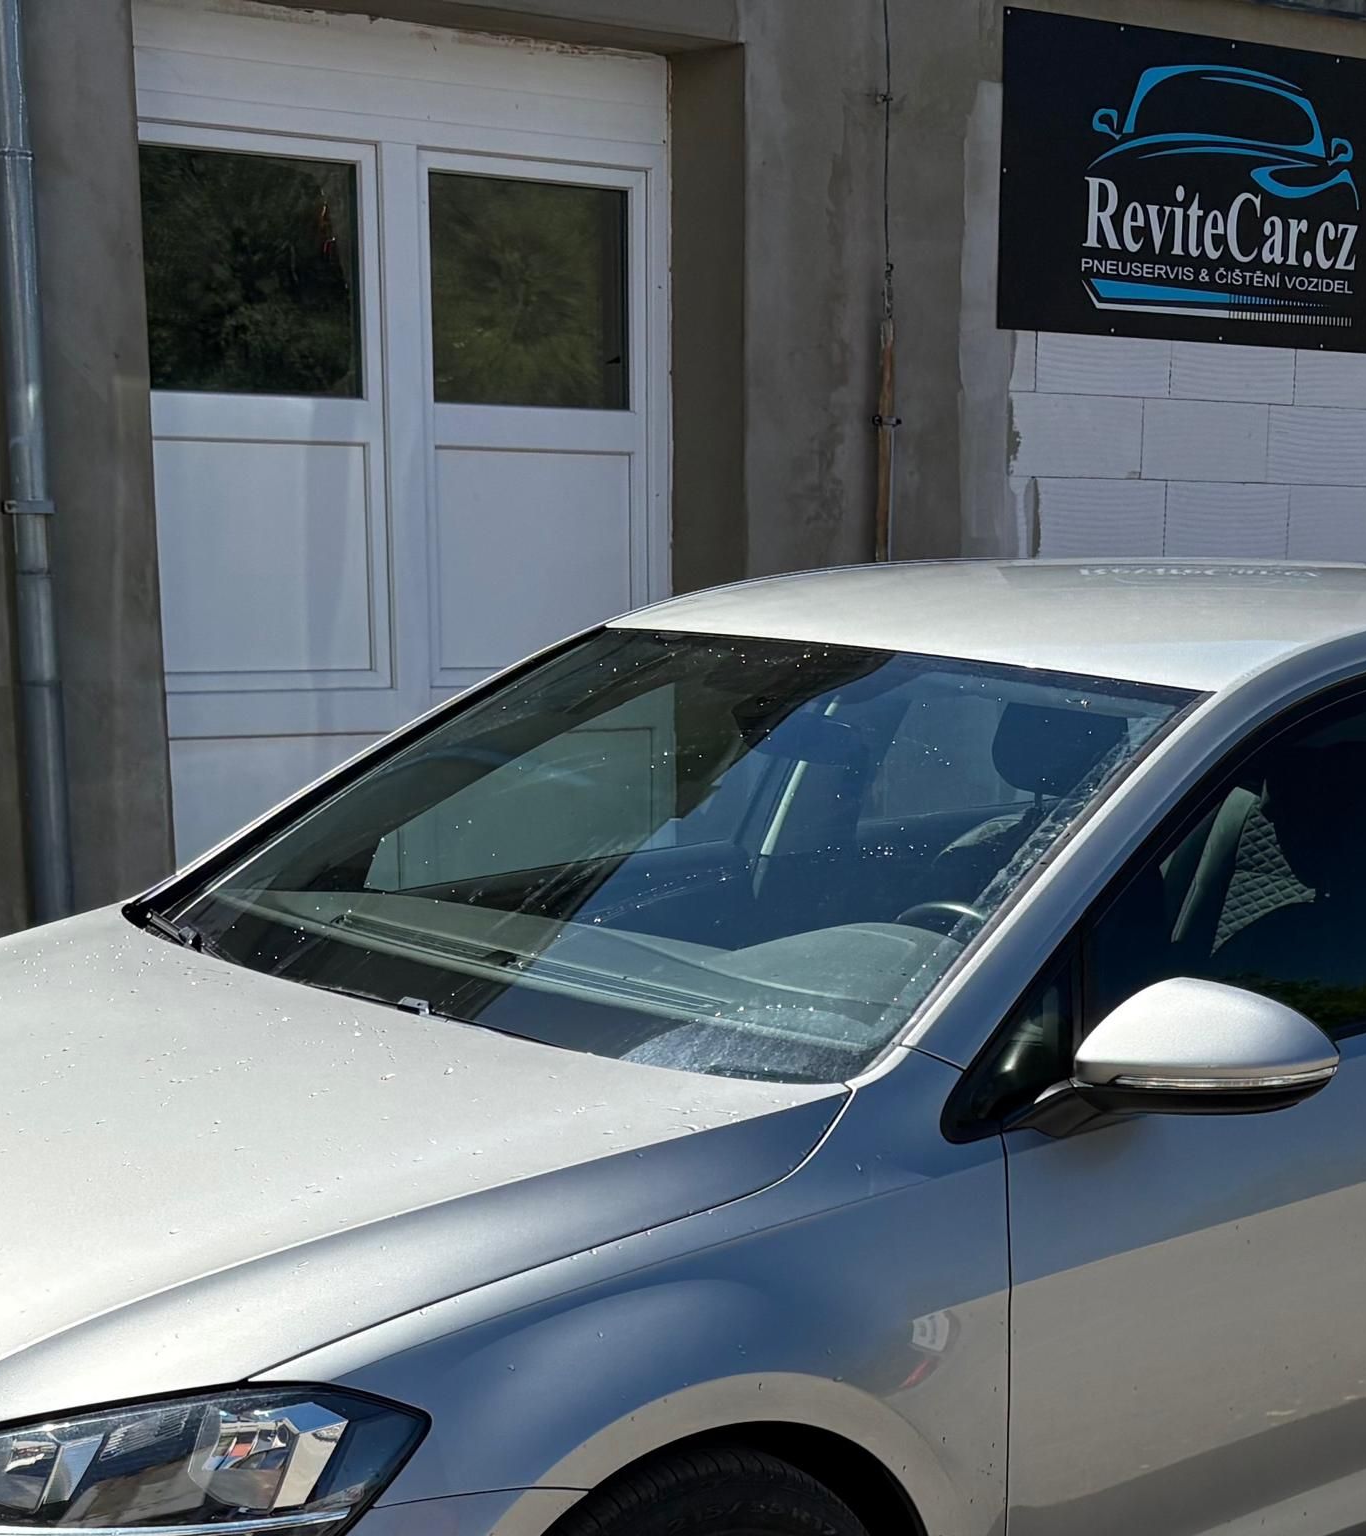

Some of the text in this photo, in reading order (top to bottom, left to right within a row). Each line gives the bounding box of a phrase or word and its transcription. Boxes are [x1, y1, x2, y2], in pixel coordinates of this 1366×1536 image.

[1082, 176, 1359, 270] ReviteCar.cz
[1081, 258, 1354, 294] PNEUSERVIS & ČIŠTĚNÍ VOZIDEL
